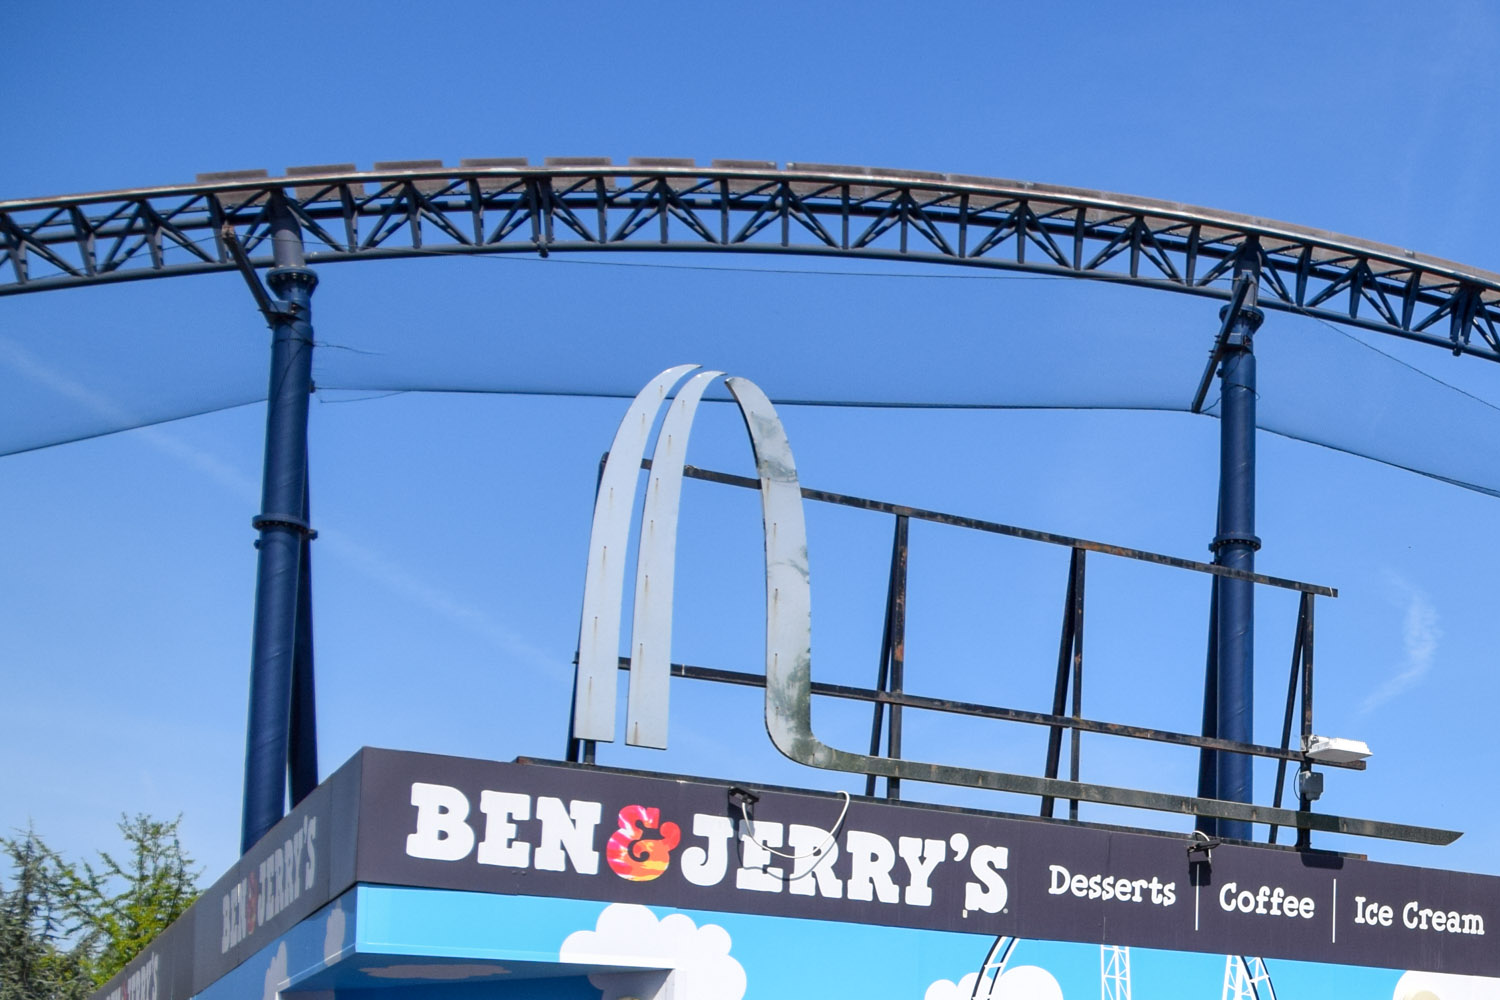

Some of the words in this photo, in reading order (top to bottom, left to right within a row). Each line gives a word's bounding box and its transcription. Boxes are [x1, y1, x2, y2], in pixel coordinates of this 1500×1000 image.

[1048, 864, 1176, 906] Desserts
[1219, 882, 1315, 918] Coffee
[1354, 896, 1393, 926] Ice
[1402, 901, 1485, 935] Cream
